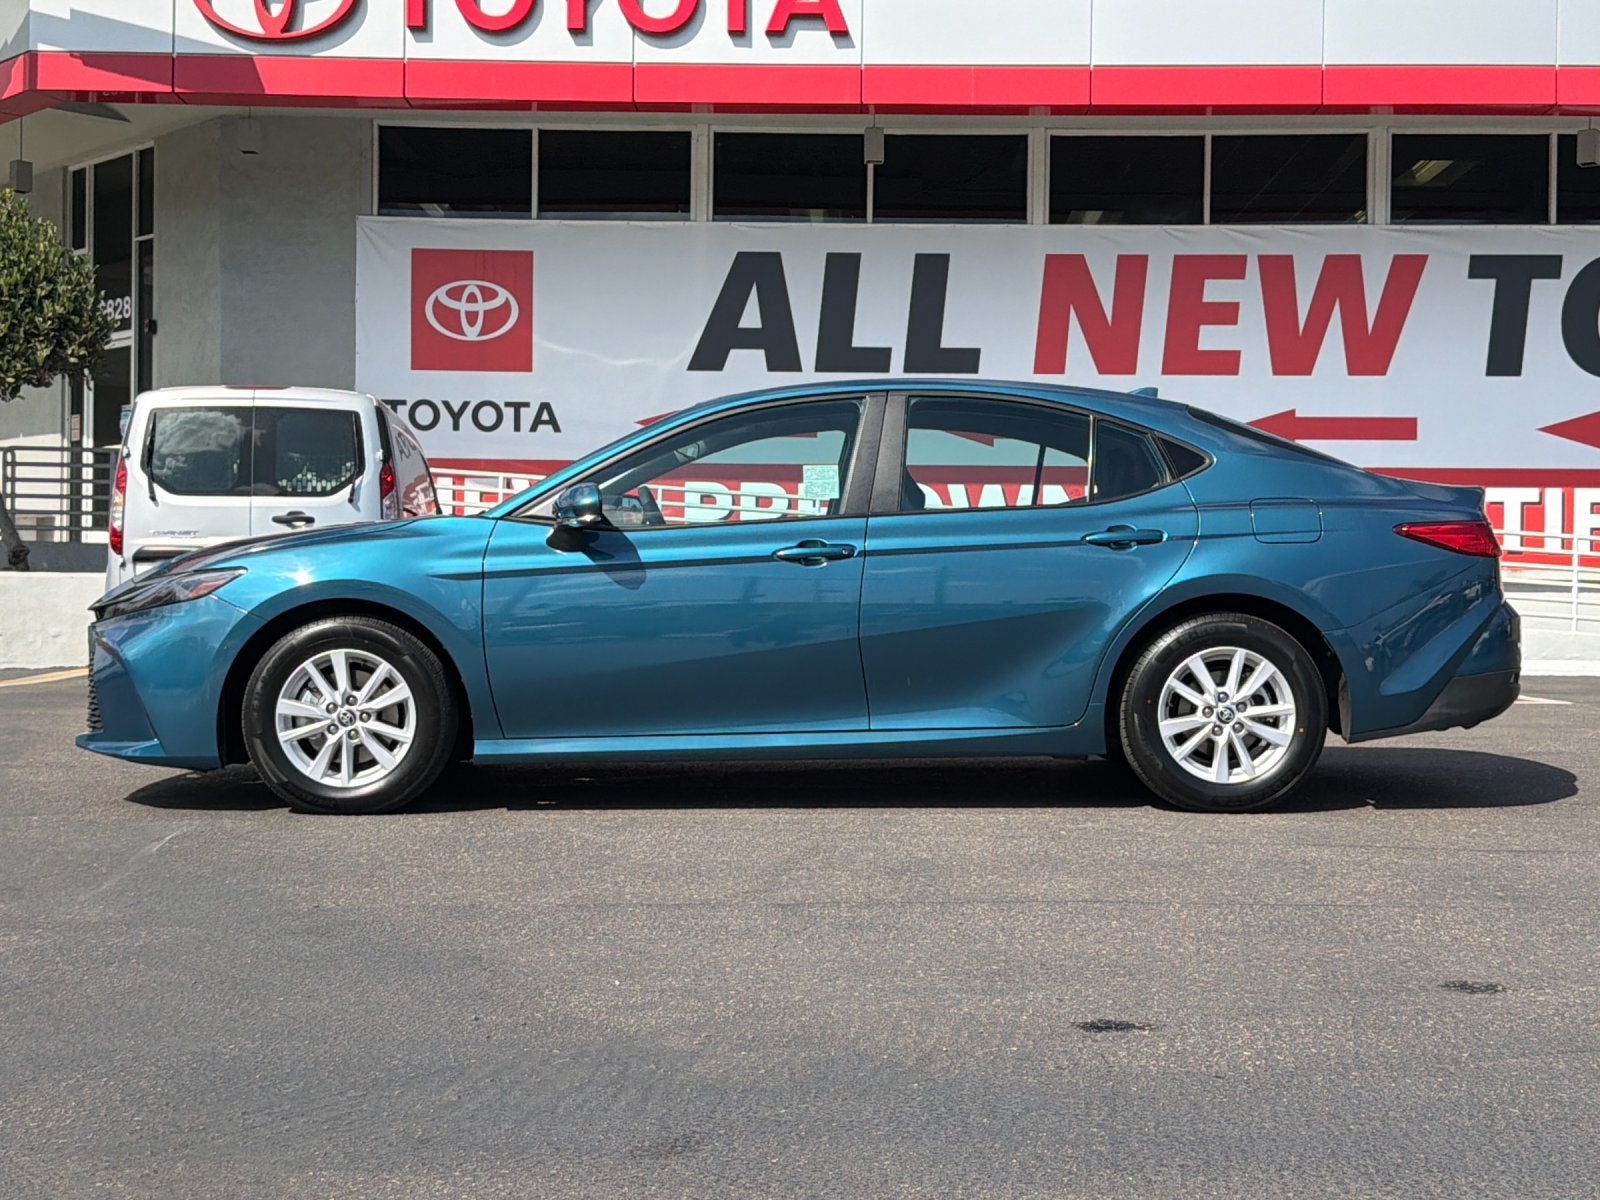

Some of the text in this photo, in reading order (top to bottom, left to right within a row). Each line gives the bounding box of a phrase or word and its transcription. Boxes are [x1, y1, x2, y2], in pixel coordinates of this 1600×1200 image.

[98, 295, 132, 321] 828
[686, 251, 981, 374] ALL
[1033, 253, 1429, 376] NEW
